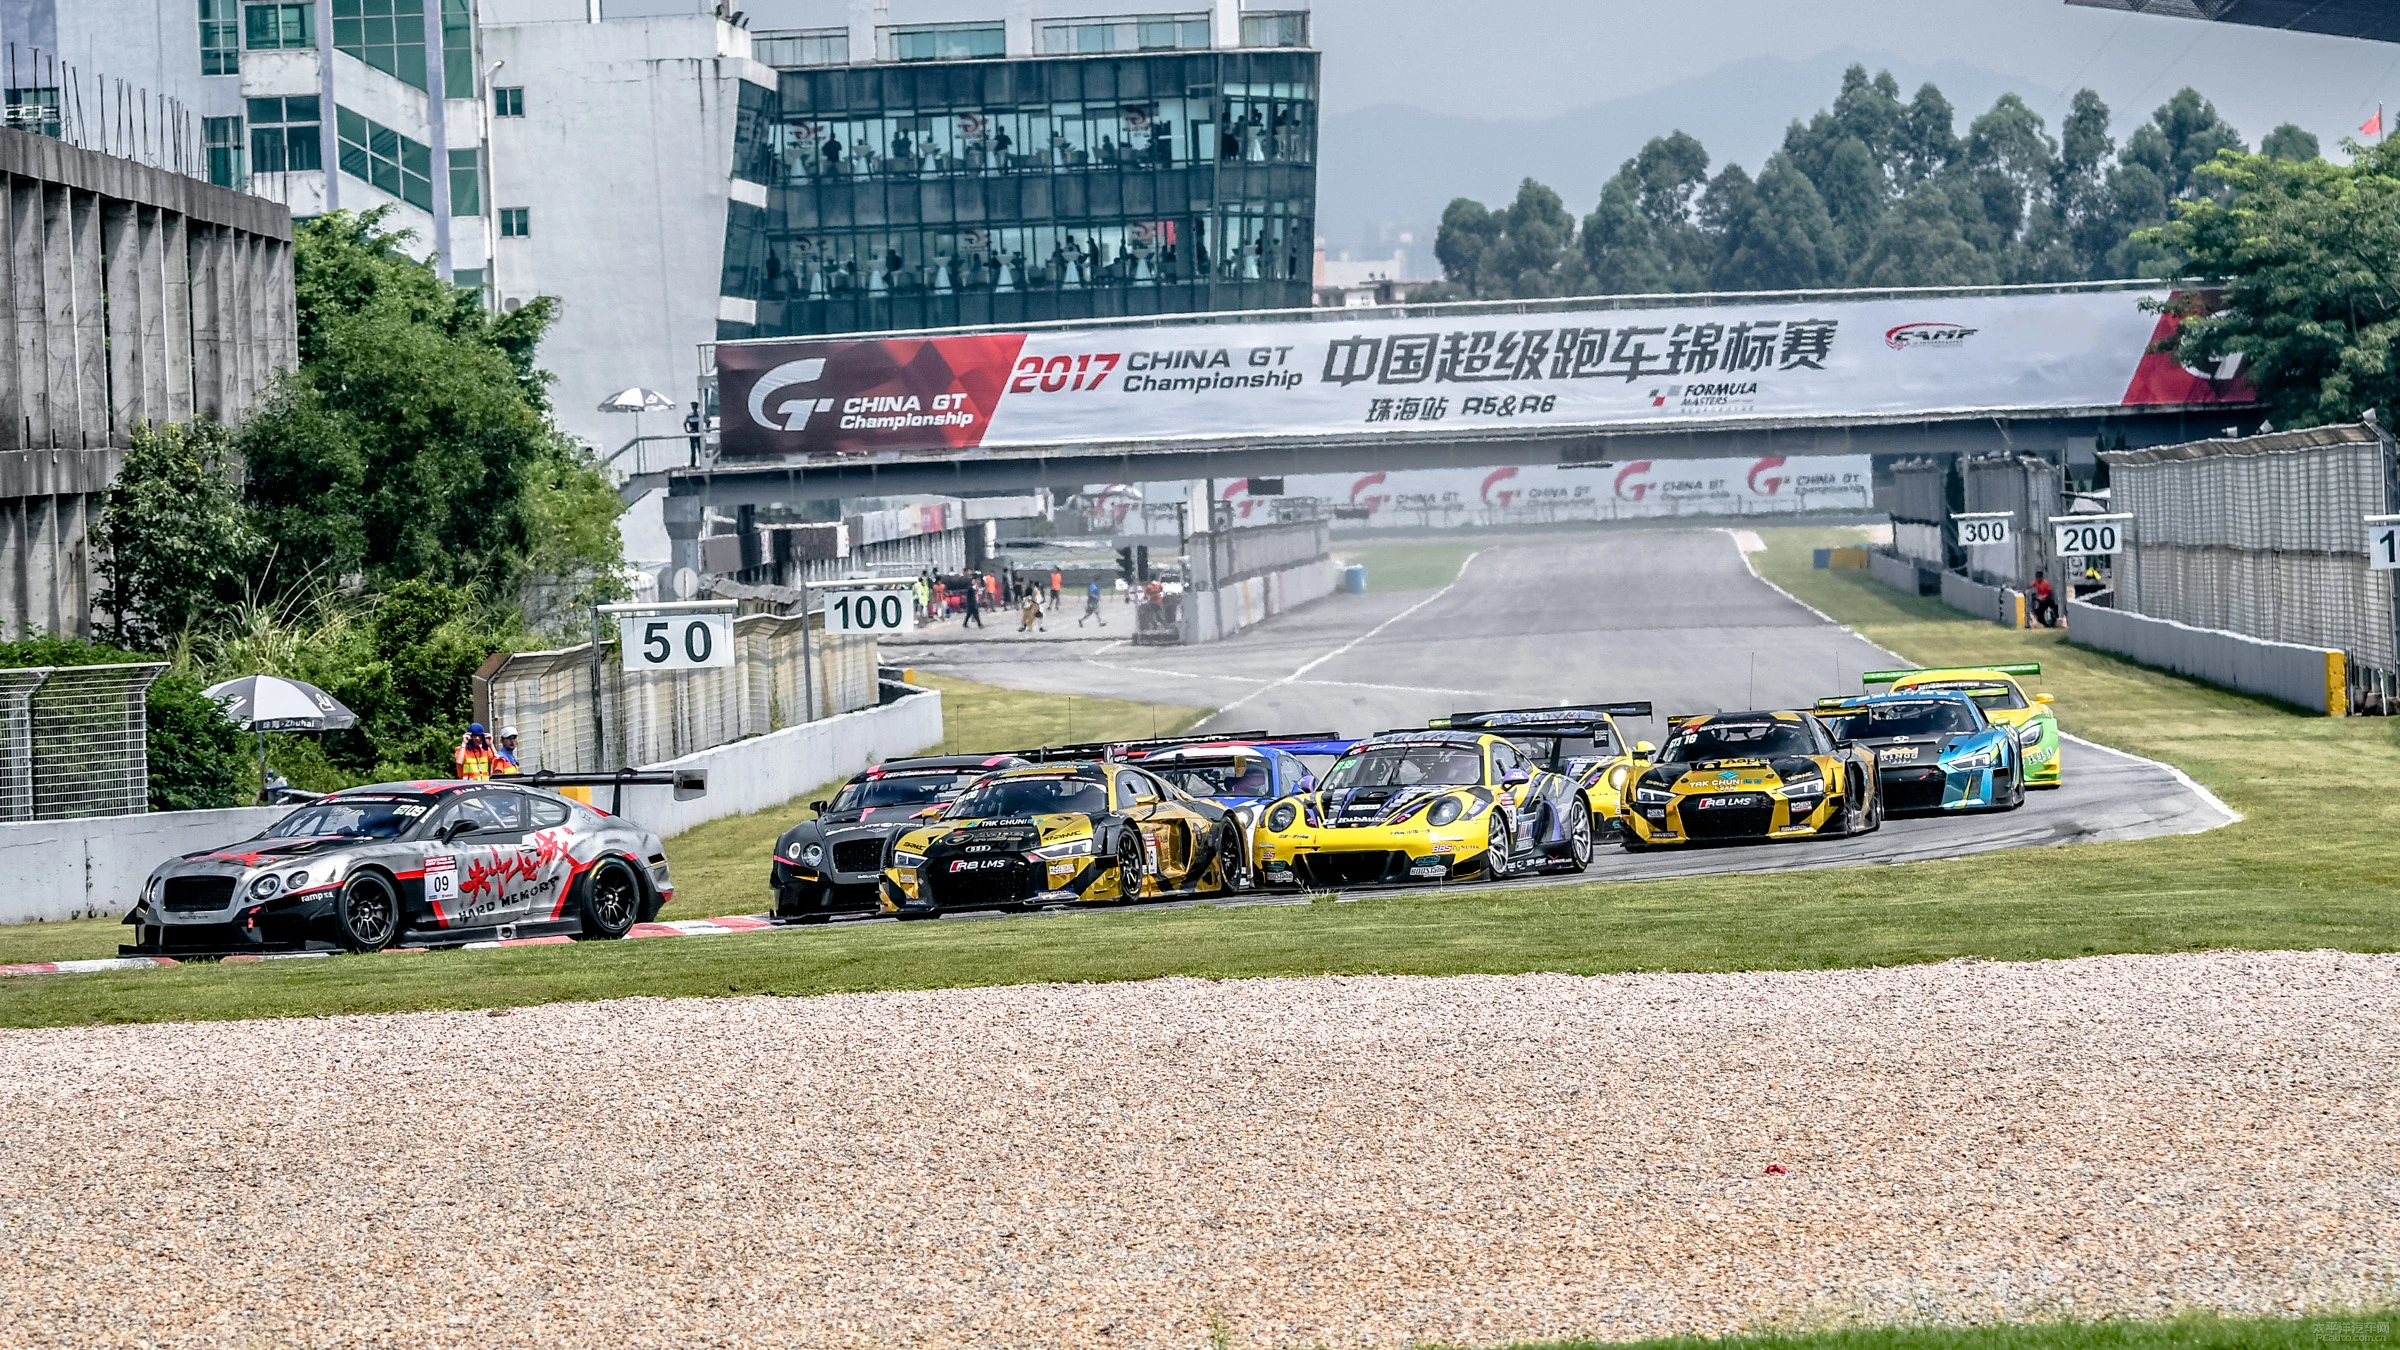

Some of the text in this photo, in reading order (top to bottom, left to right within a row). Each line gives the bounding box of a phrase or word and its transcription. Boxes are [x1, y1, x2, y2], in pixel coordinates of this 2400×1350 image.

[1126, 346, 1294, 372] CHINA GT
[1320, 317, 1839, 386] 中国超级跑车锦标赛
[1009, 353, 1121, 394] 2017
[1122, 368, 1304, 394] Championship
[1684, 382, 1757, 397] FORMULA
[843, 392, 967, 413] CHINA GT
[1364, 394, 1556, 424] 珠海站 R5&R6
[1681, 397, 1728, 406] MASTERS
[840, 409, 974, 430] Championship
[1663, 481, 1703, 491] CHINA
[1796, 473, 1838, 484] CHINA
[1964, 523, 2004, 542] 300
[2064, 527, 2115, 552] 200
[834, 595, 901, 630] 100
[643, 621, 712, 663] 50
[284, 719, 315, 728] Zhuhai
[1728, 797, 1751, 806] LMS
[1000, 818, 1025, 826] CHUN
[1431, 844, 1452, 852] BBS
[981, 860, 1005, 868] LMS
[434, 876, 449, 892] 09
[458, 902, 496, 922] HARD
